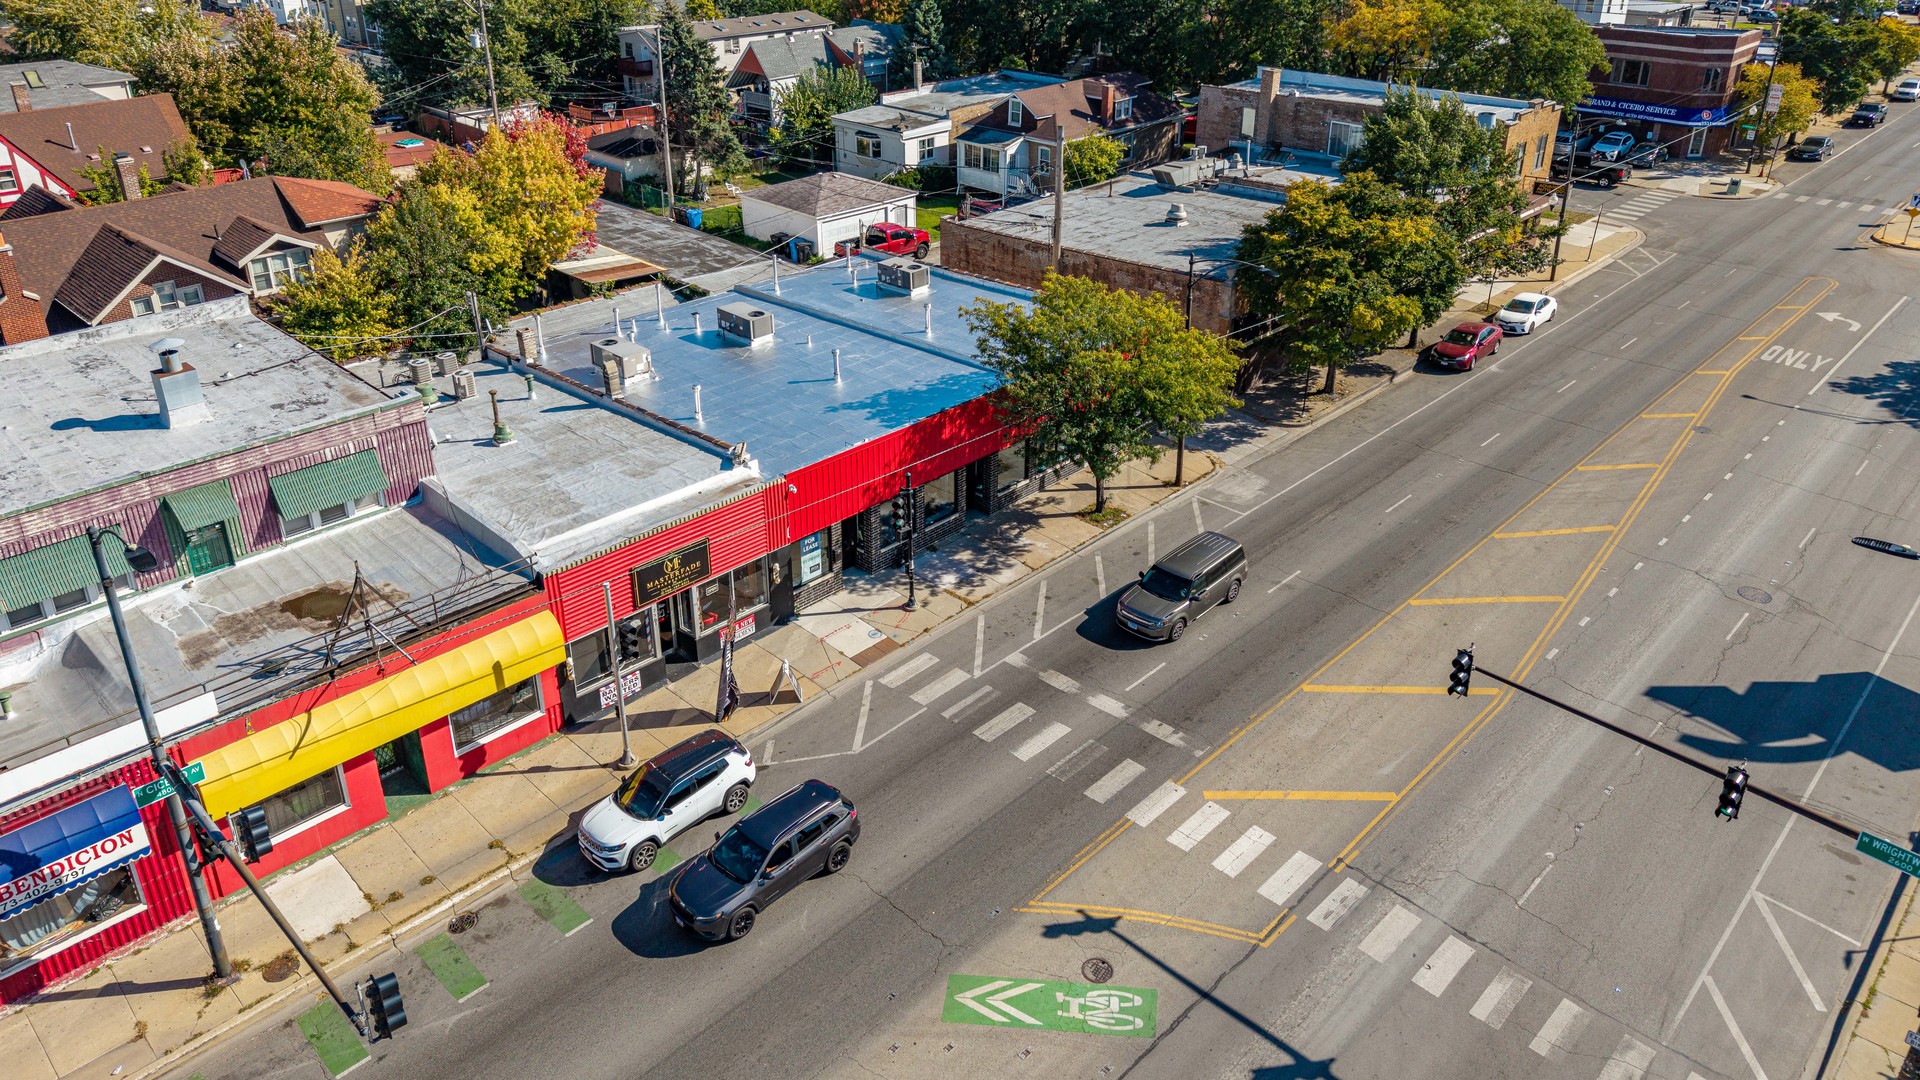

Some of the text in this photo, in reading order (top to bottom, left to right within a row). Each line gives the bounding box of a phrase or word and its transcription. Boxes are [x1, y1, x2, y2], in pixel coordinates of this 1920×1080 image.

[1618, 102, 1645, 111] CICERO
[1645, 105, 1677, 116] SERVICE
[1760, 345, 1834, 372] ONLY
[802, 541, 819, 552] LEASE
[804, 536, 816, 545] FOR
[646, 561, 702, 589] MASTERFADE
[740, 617, 753, 628] NEW
[604, 682, 638, 701] WATED
[190, 766, 200, 775] AV
[156, 786, 175, 797] 480
[1862, 835, 1870, 843] W
[0, 829, 134, 901] BENDICION
[1888, 856, 1913, 871] 2600
